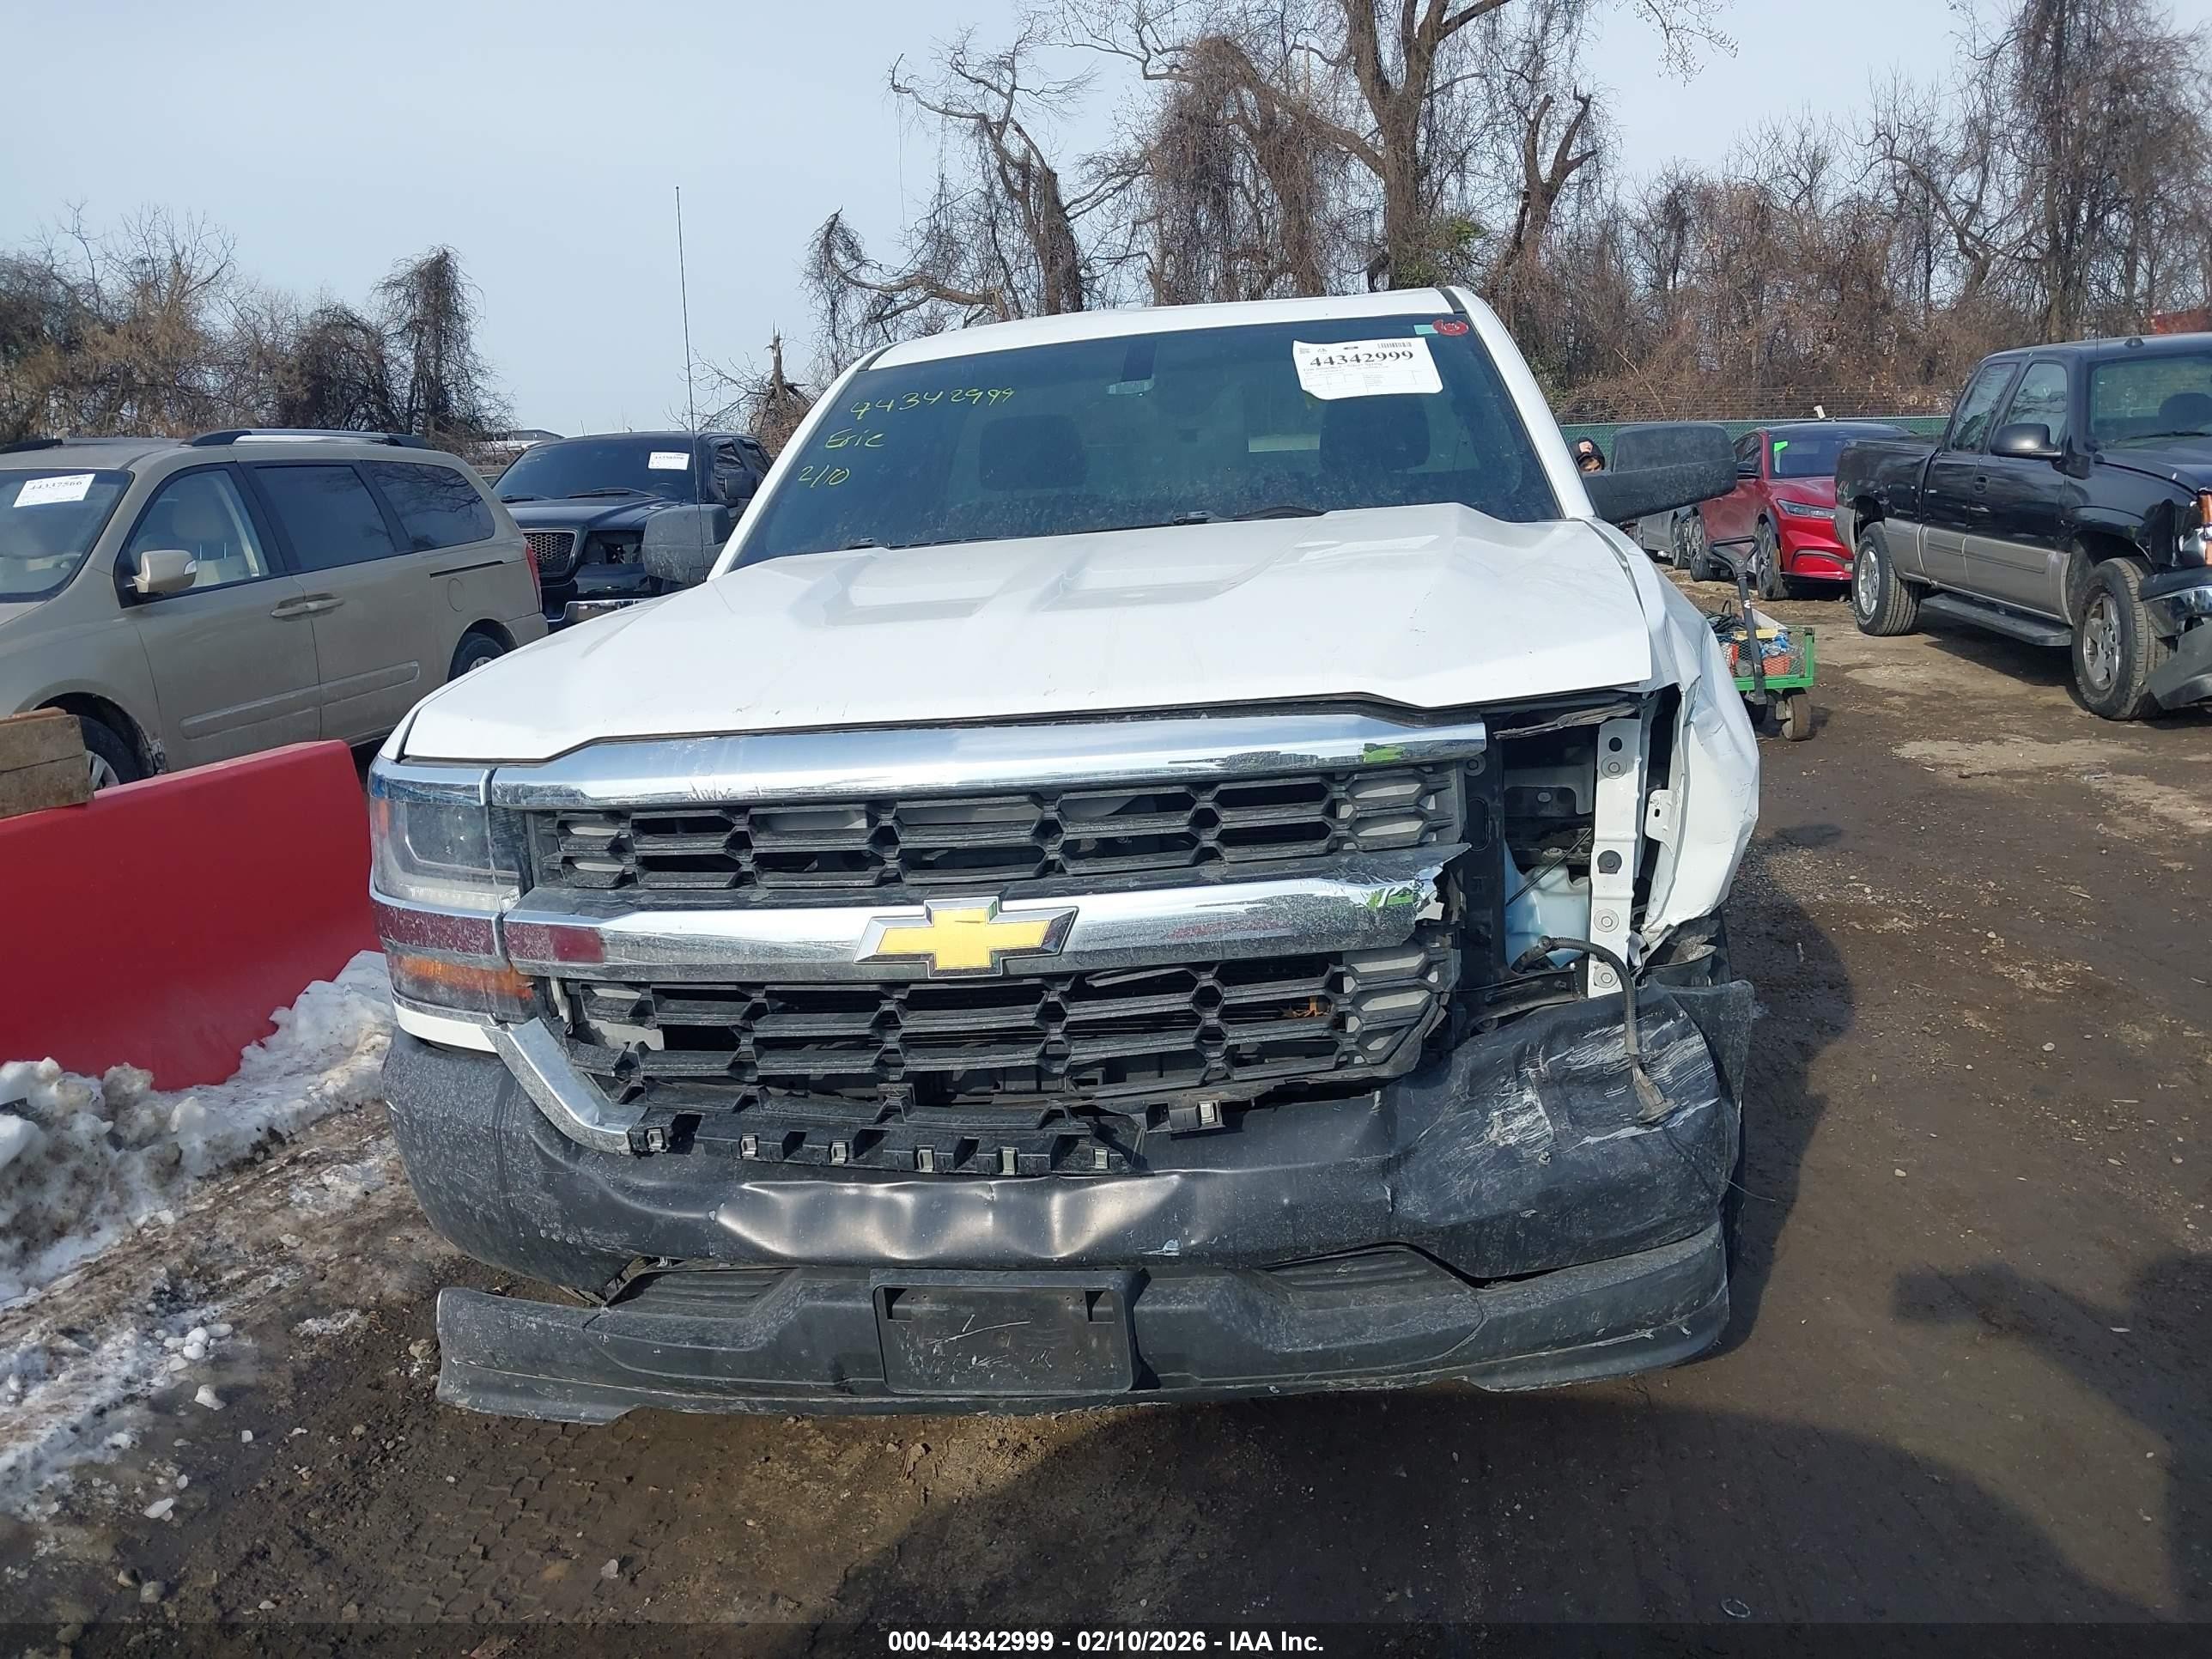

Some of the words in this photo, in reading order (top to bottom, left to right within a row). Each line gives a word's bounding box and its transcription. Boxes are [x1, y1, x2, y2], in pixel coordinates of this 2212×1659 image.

[1310, 350, 1413, 367] 44342999
[850, 388, 1015, 420] 44342999
[825, 428, 886, 449] Eric
[798, 465, 850, 488] 2/10
